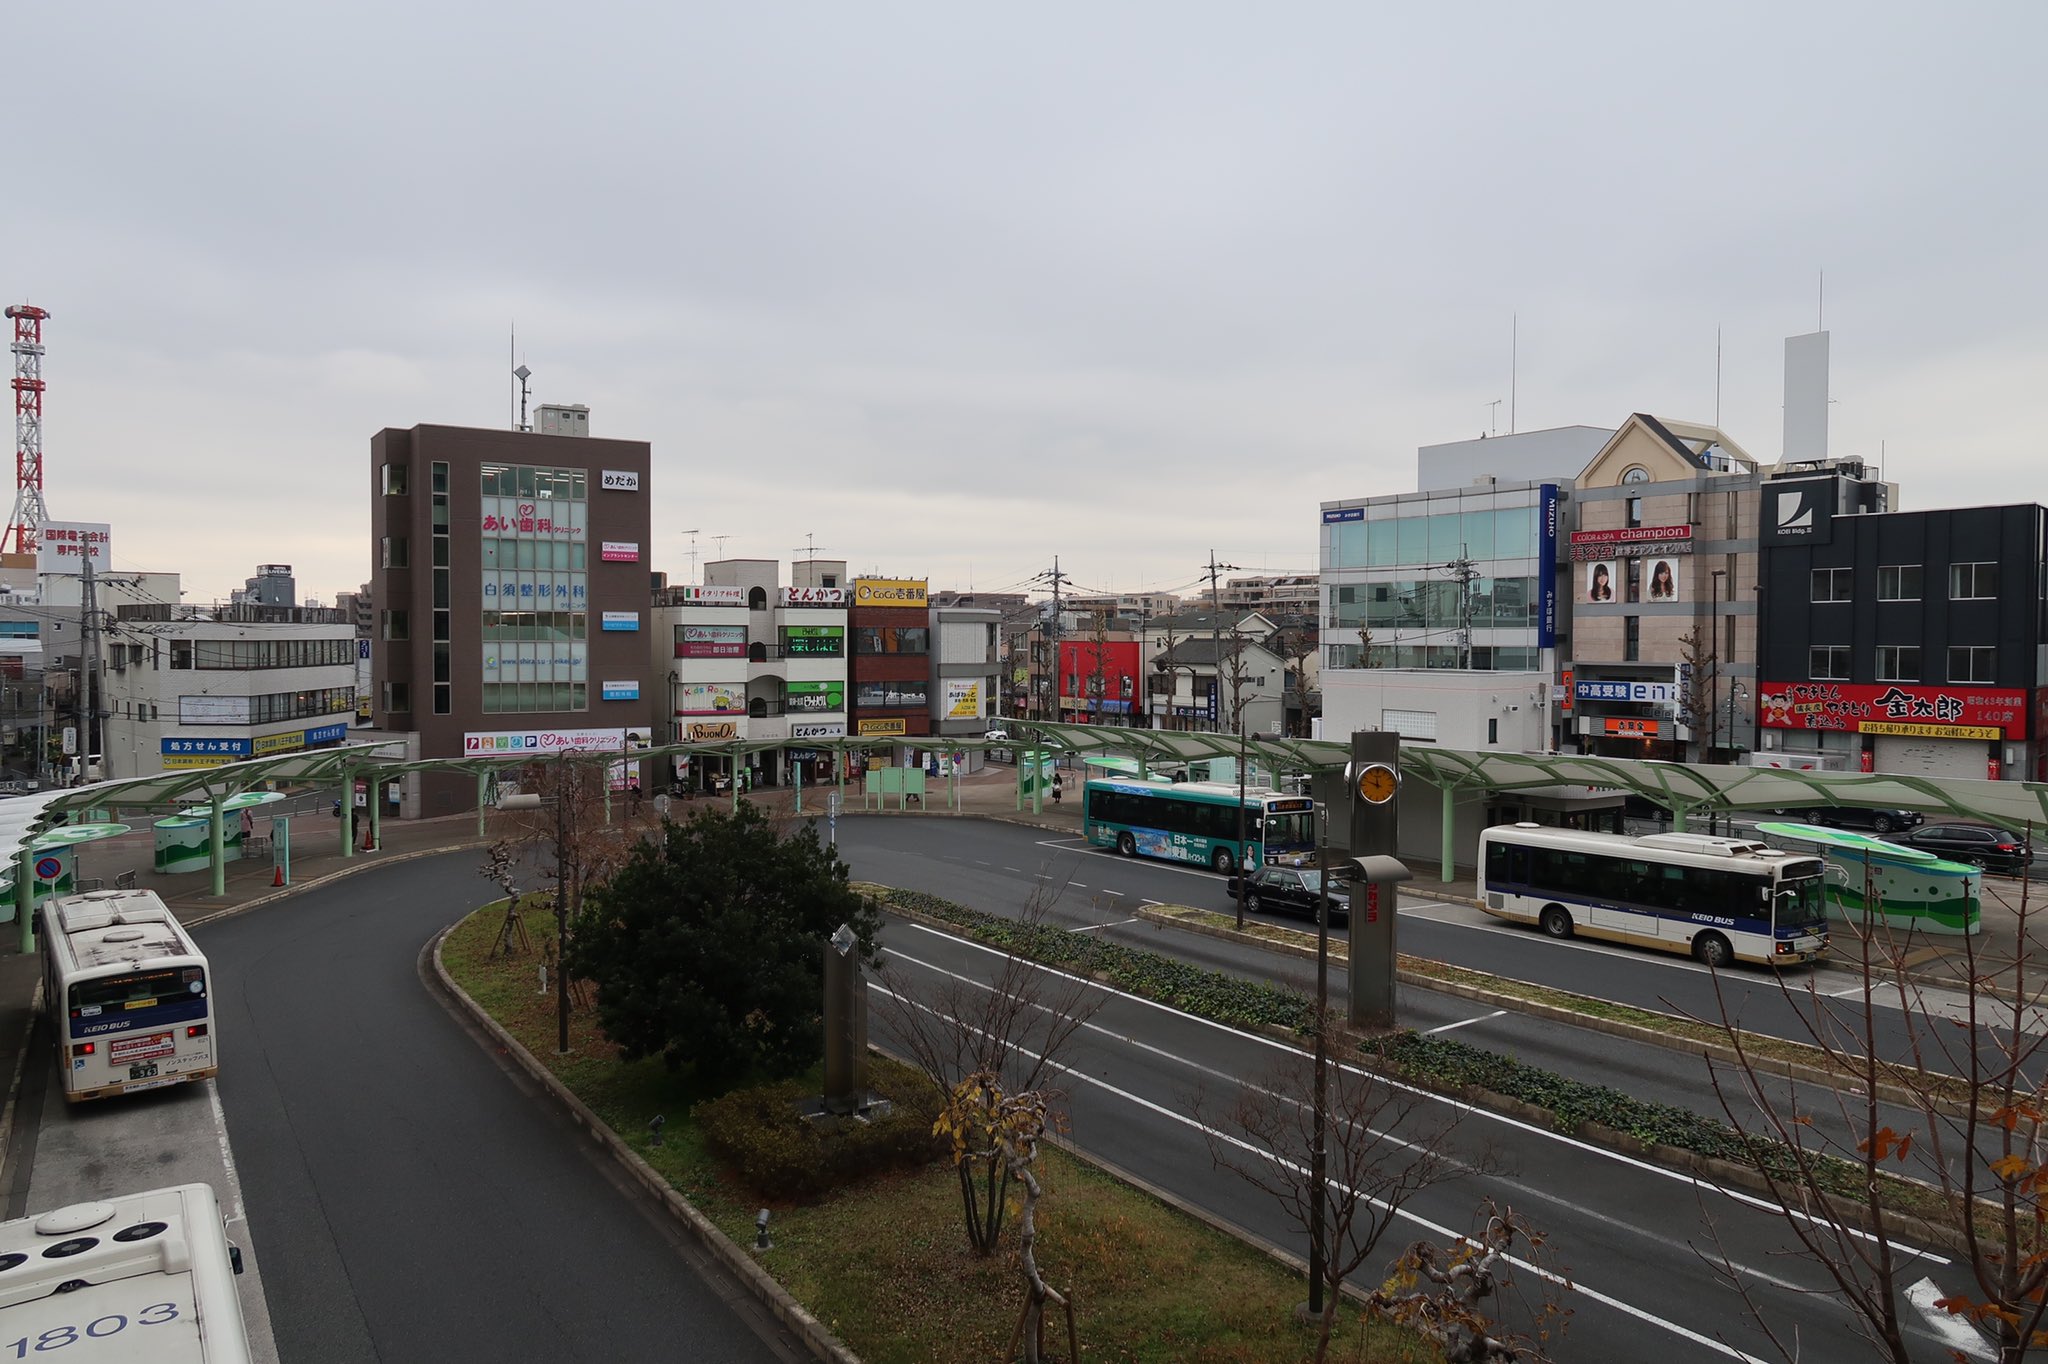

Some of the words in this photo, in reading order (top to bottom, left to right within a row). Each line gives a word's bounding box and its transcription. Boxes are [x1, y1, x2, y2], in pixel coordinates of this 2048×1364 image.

[604, 474, 637, 487] めだか
[1547, 497, 1556, 537] MIZUHO
[46, 529, 109, 543] 国際電子会計
[1620, 527, 1683, 541] champion
[1570, 543, 1616, 561] 美容室
[484, 582, 586, 599] 白須整形外科
[700, 589, 740, 599] イタリア料理
[788, 587, 842, 602] とんかつ
[873, 587, 925, 601] CoCo壱番屋
[1546, 590, 1554, 633] みずほ銀行
[684, 686, 704, 696] Kids
[1578, 684, 1627, 698] 中高受験
[1634, 684, 1675, 700] en
[1794, 684, 1841, 700] やきとん
[1825, 701, 1871, 718] やきとり
[1874, 687, 1964, 722] 金太郎
[796, 728, 826, 737] とんかつ
[171, 742, 241, 751] 処方せん受付
[1174, 834, 1194, 846] 日本一
[1691, 912, 1713, 923] KEIO
[1715, 916, 1735, 926] BUS
[83, 1023, 108, 1034] KEIO
[108, 1021, 131, 1032] BUS
[166, 1053, 209, 1066] ノンステップバス
[6, 1302, 179, 1359] 1803
